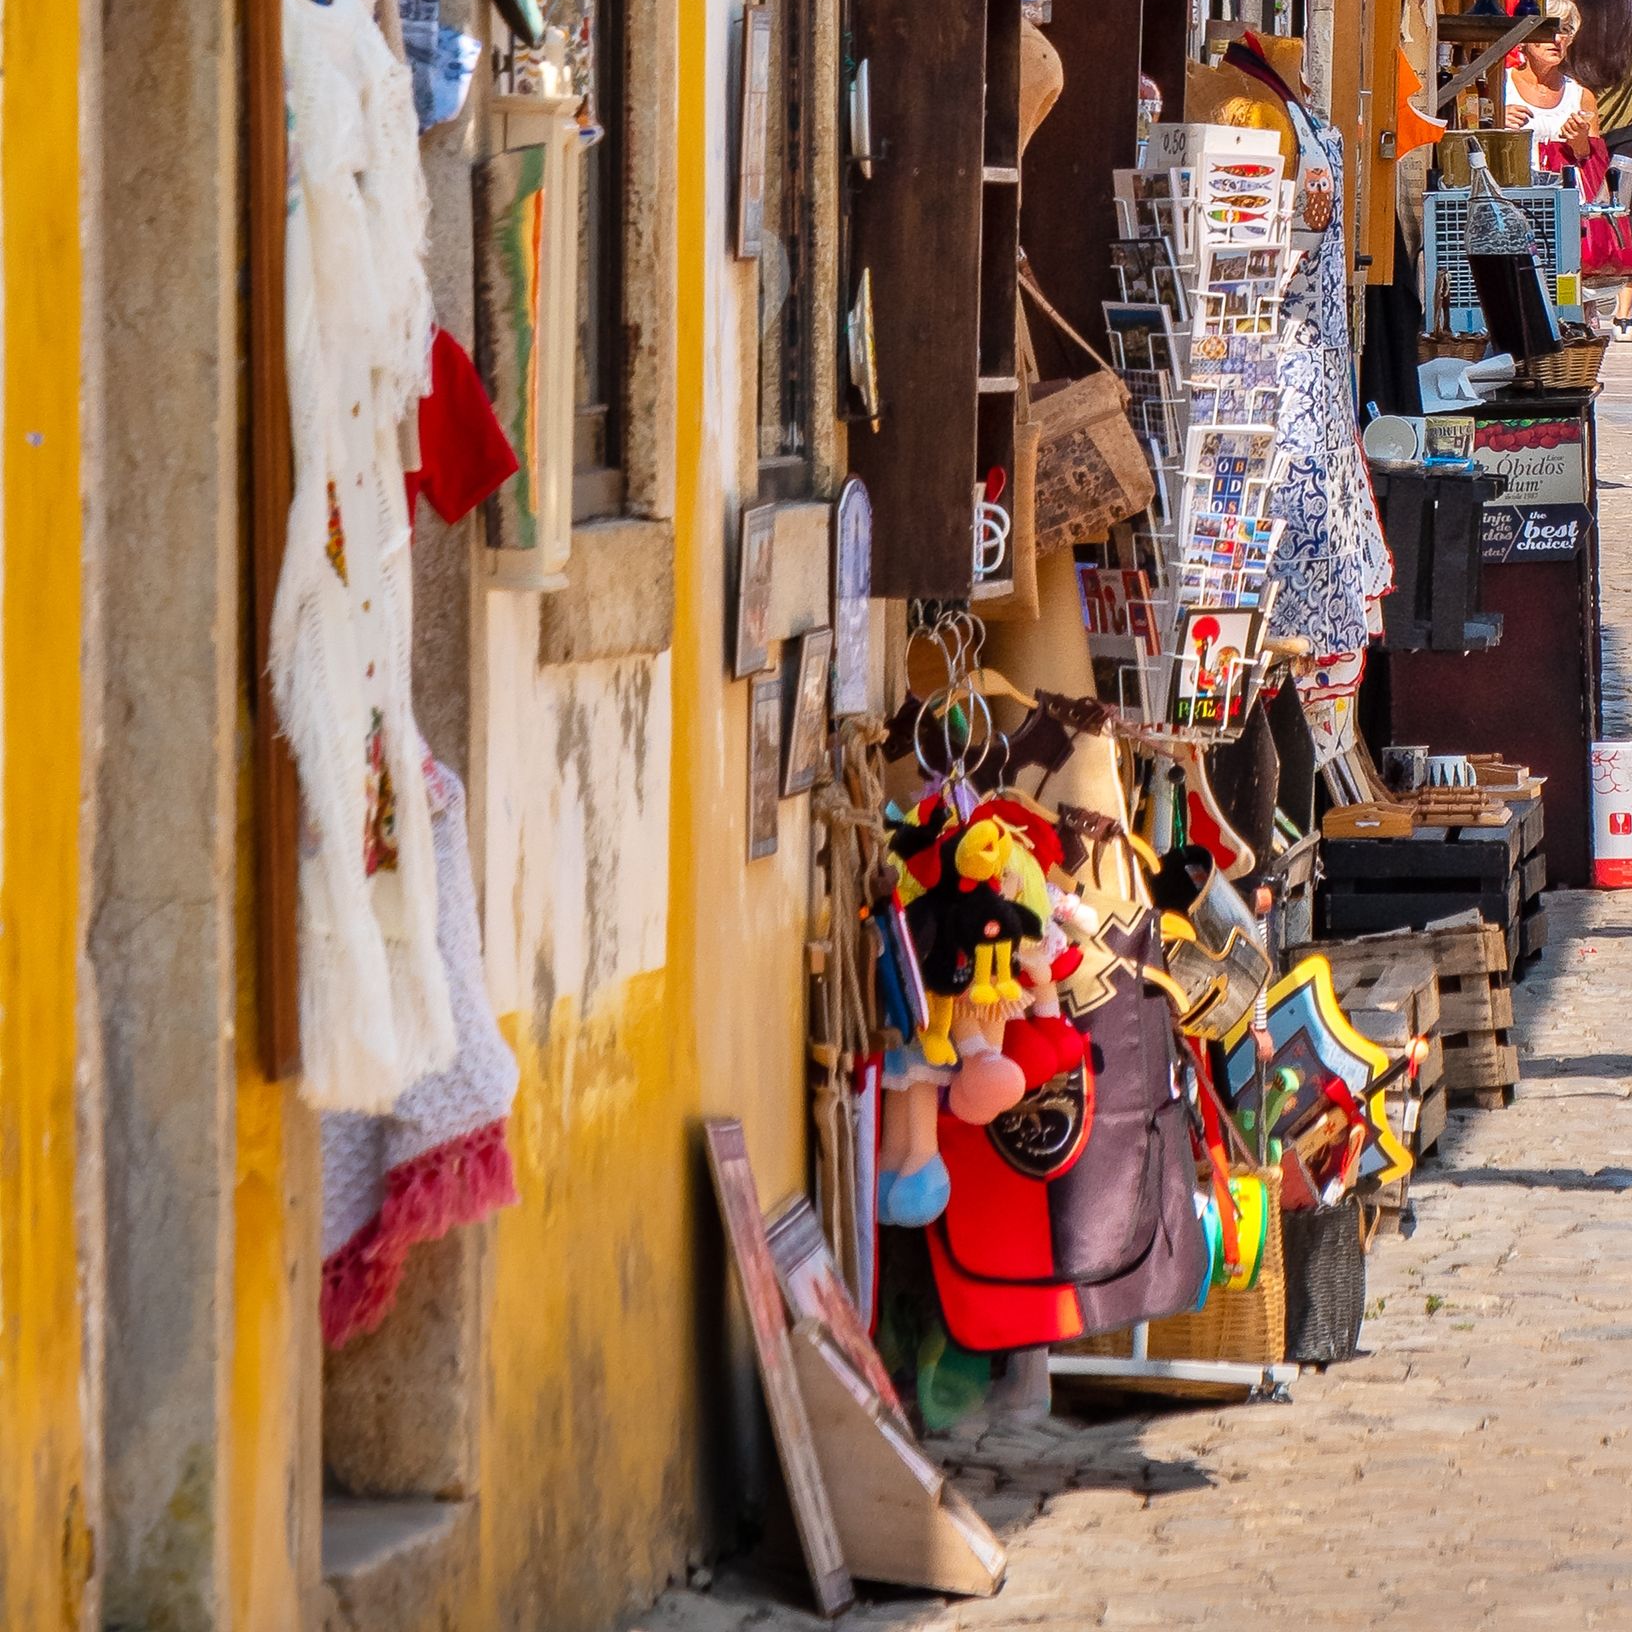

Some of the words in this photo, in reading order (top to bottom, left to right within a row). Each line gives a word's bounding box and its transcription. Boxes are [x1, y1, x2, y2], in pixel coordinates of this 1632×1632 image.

[1497, 453, 1566, 477] Óbidos
[1482, 511, 1513, 527] inja
[1529, 511, 1548, 521] the
[1482, 528, 1514, 542] dos
[1523, 518, 1580, 540] best
[1516, 537, 1577, 551] choice!
